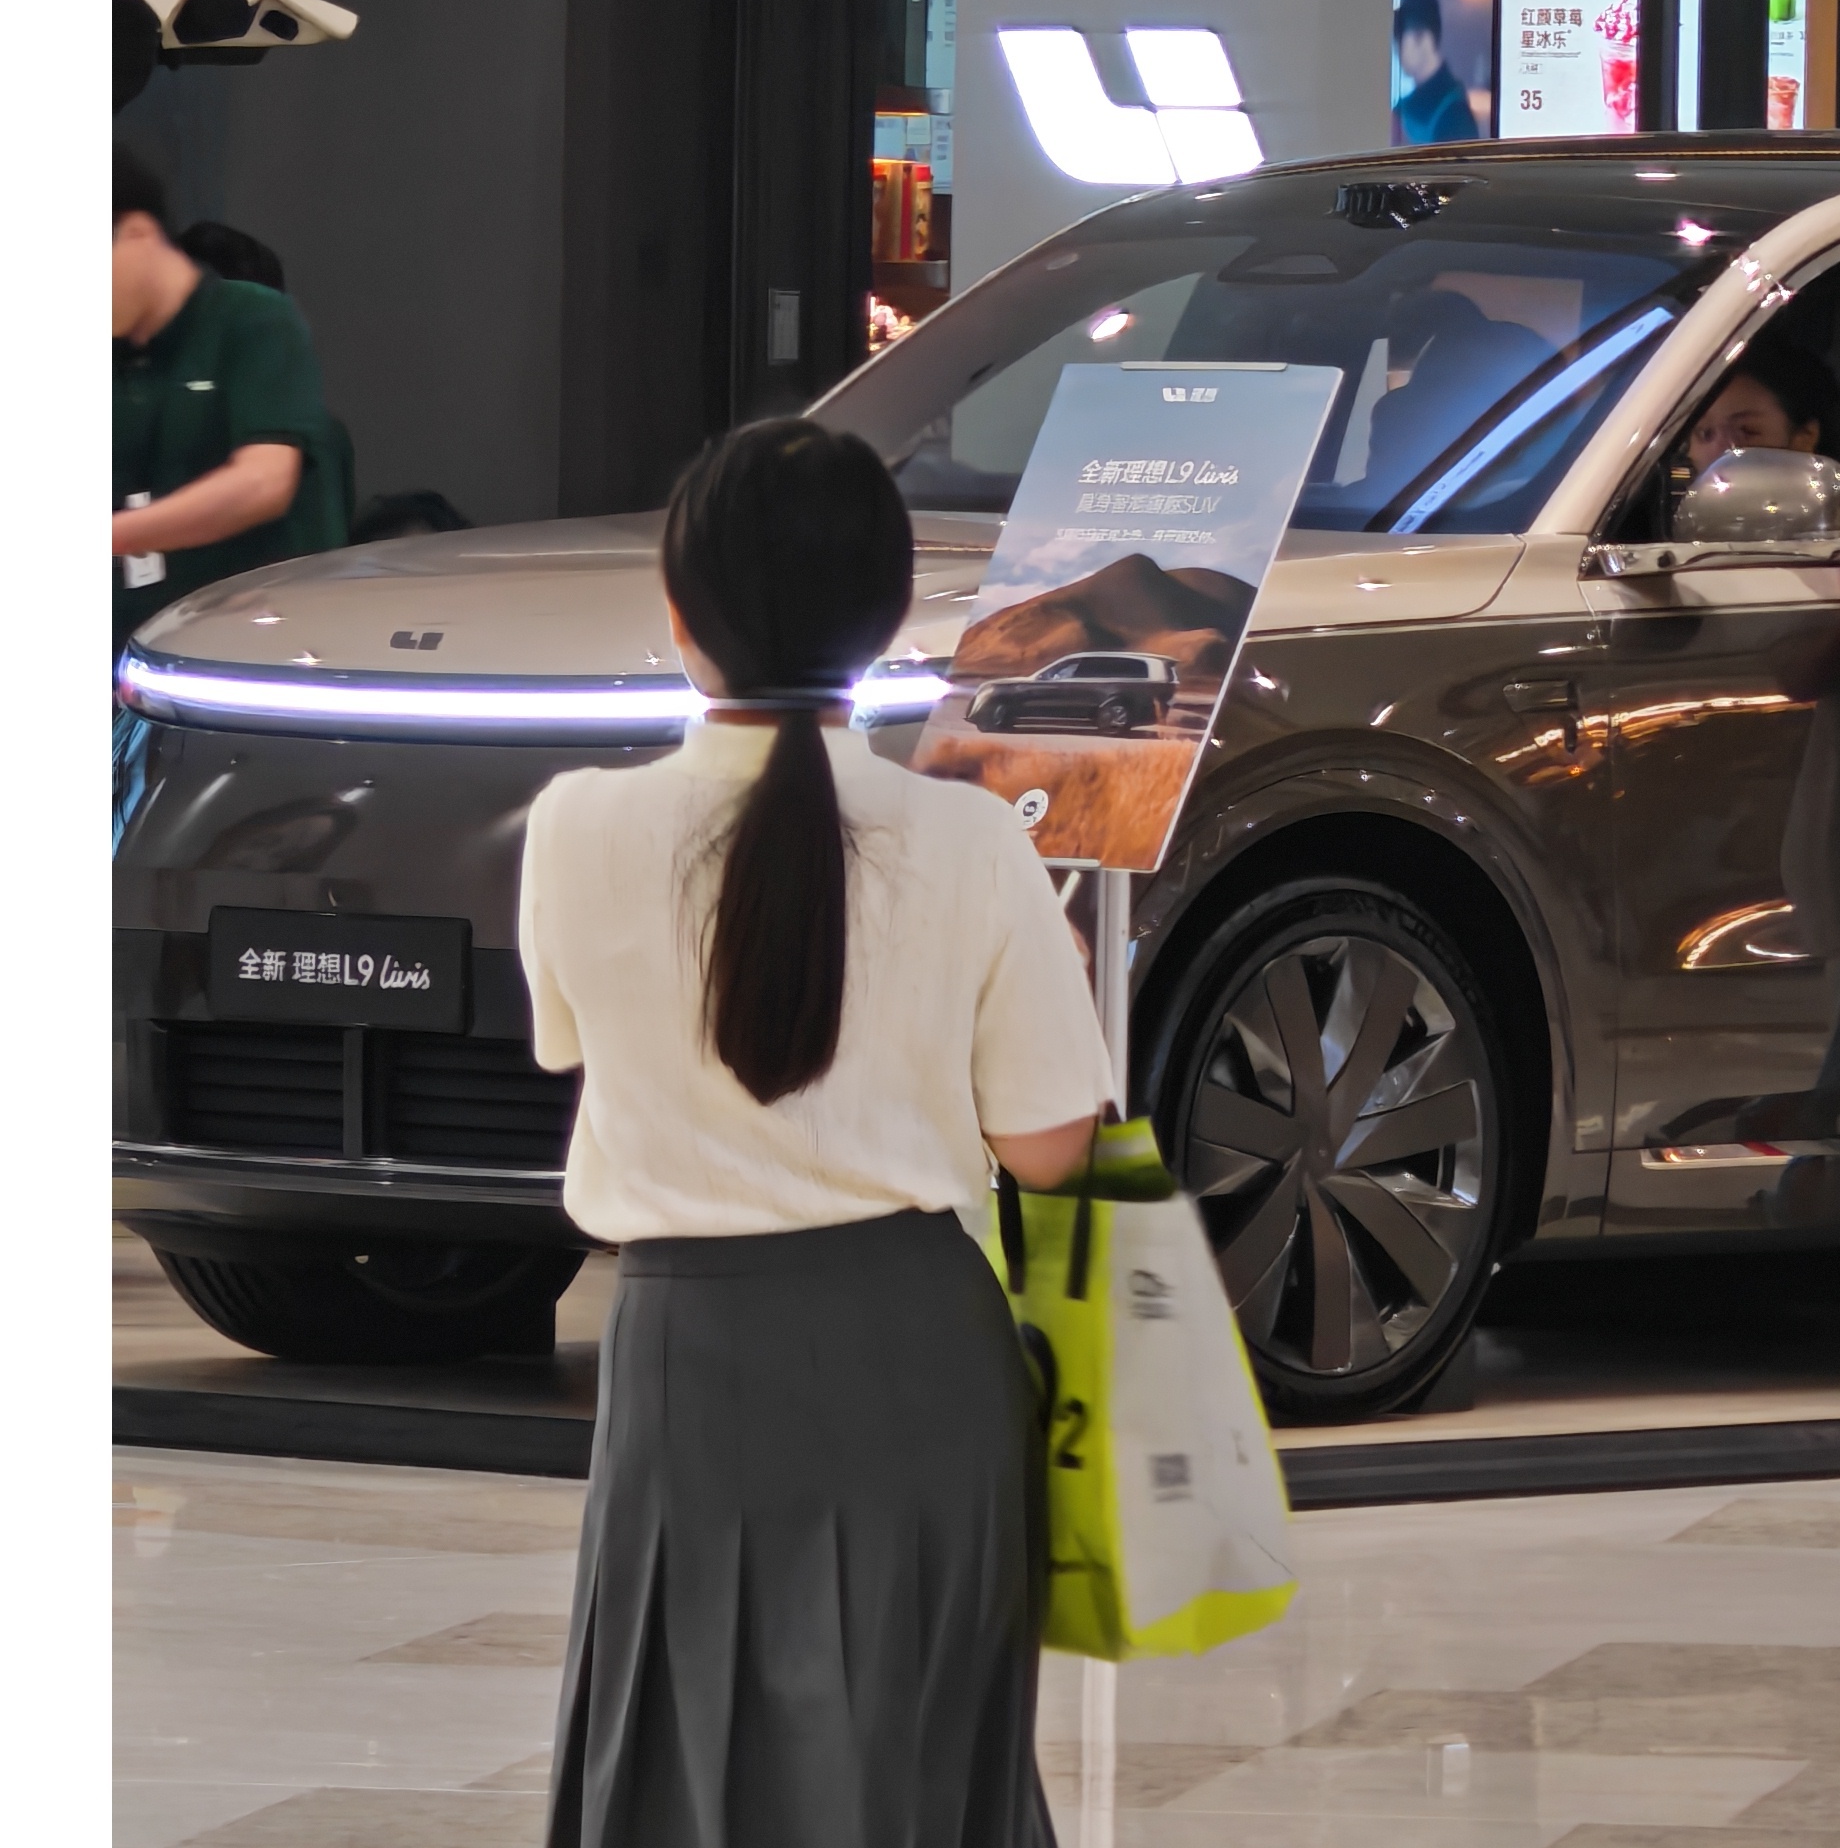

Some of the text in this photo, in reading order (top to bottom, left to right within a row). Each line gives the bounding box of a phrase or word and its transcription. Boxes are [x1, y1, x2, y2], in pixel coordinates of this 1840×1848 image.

[1520, 89, 1543, 111] 35
[238, 947, 287, 982] 全新
[291, 951, 375, 987] 理想L9
